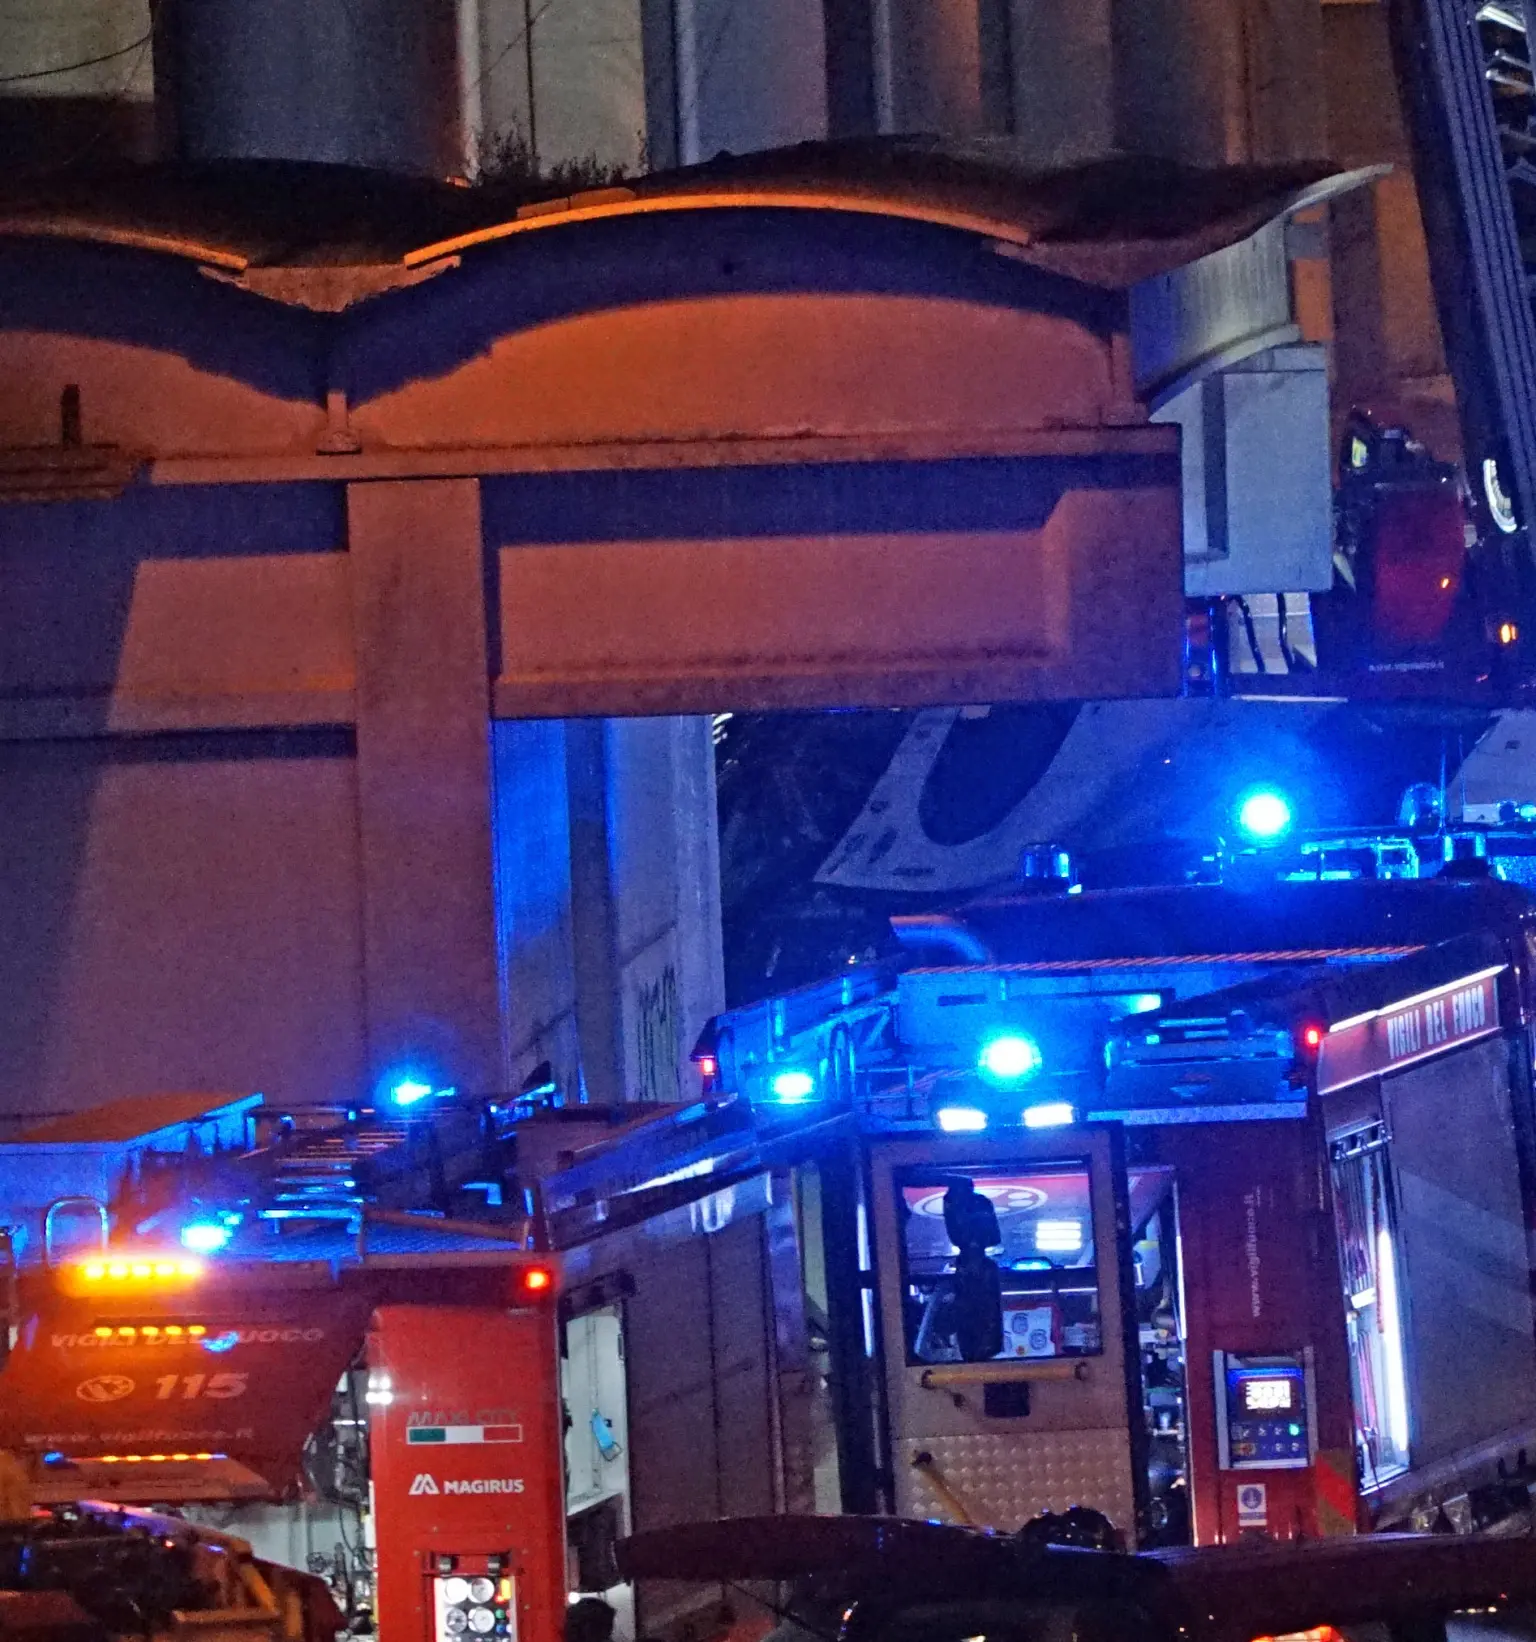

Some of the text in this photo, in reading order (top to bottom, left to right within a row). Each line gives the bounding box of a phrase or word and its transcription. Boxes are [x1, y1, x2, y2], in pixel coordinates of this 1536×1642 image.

[1387, 984, 1485, 1060] VIGILI DEL FUOCO
[51, 1330, 136, 1348] VIGILI
[154, 1372, 250, 1400] 115
[443, 1479, 525, 1495] MAGIRUS
